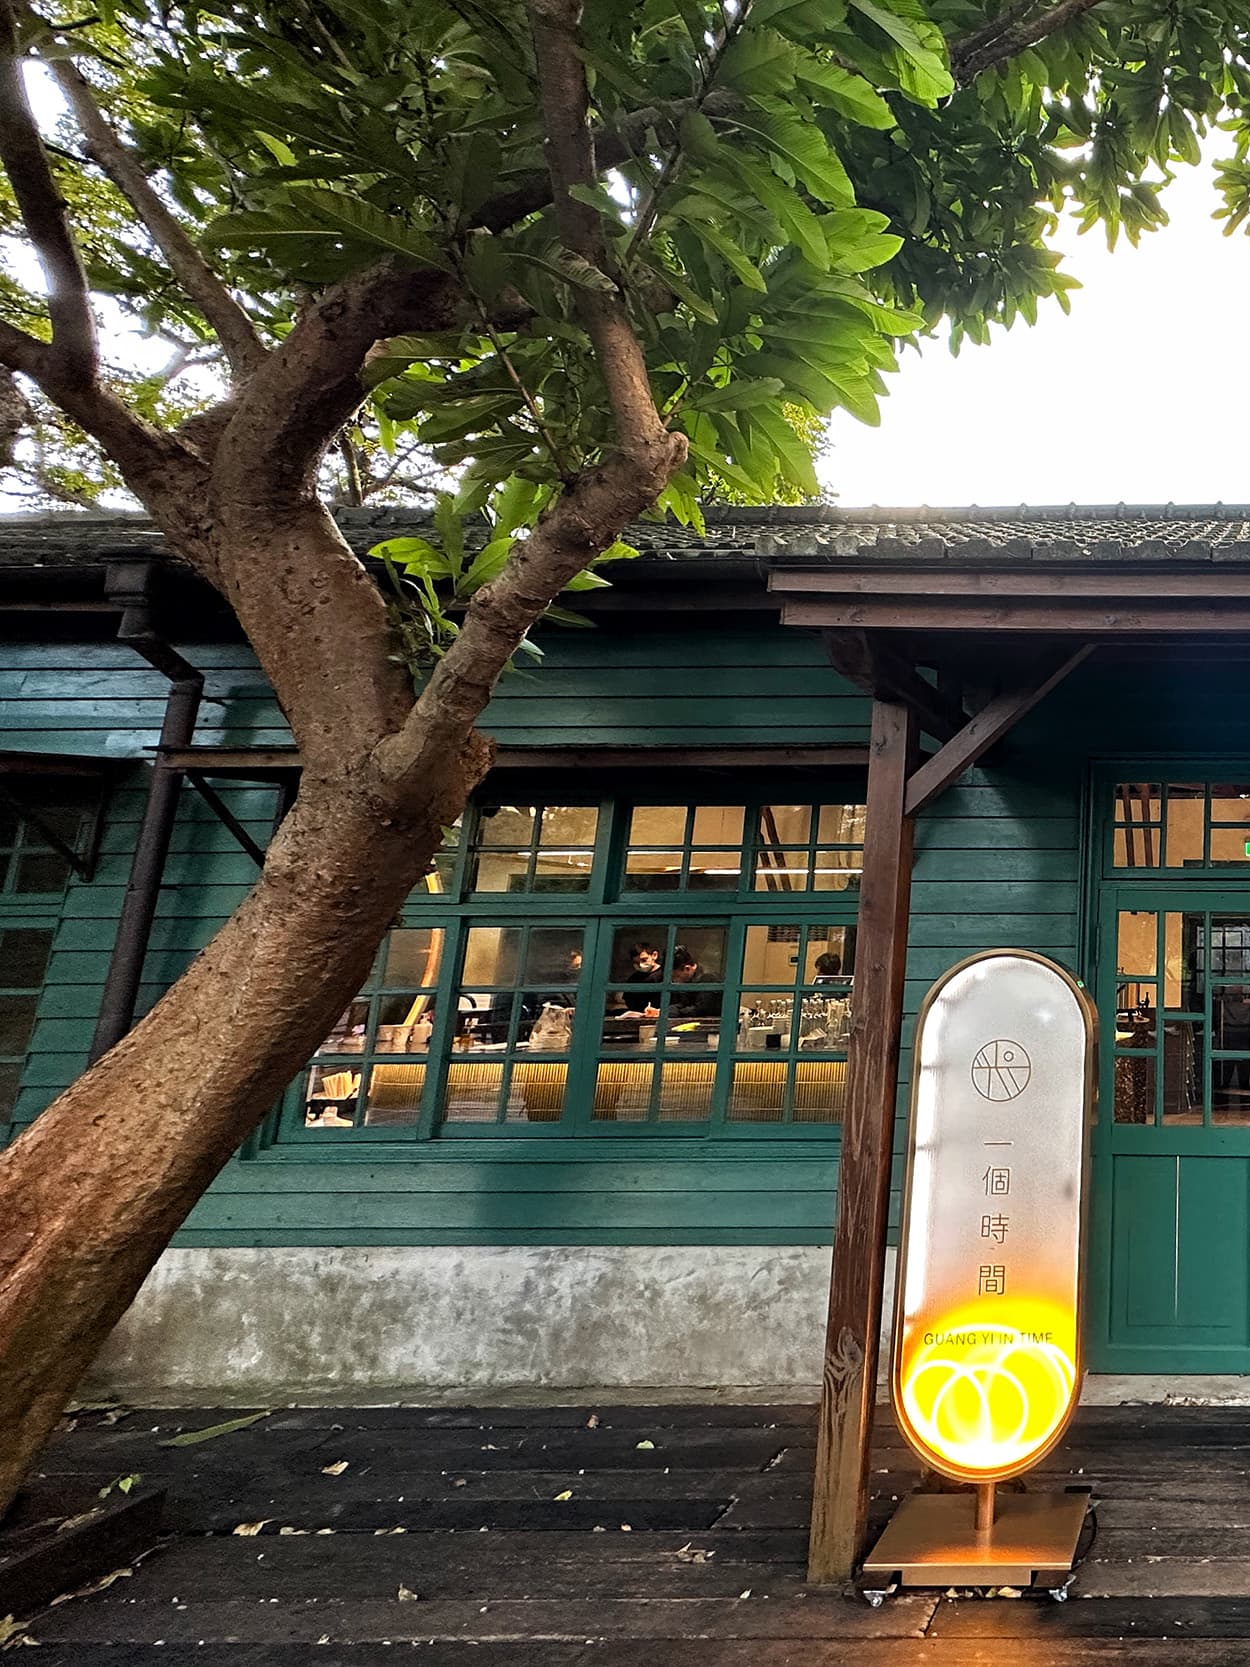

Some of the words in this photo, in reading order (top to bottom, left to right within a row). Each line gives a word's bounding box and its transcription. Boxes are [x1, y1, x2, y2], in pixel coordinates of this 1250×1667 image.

[978, 1141, 1013, 1296] 一個時間
[923, 1332, 977, 1345] GUANG
[981, 1332, 994, 1345] YI
[999, 1332, 1014, 1345] IN
[1019, 1331, 1053, 1345] TIME
